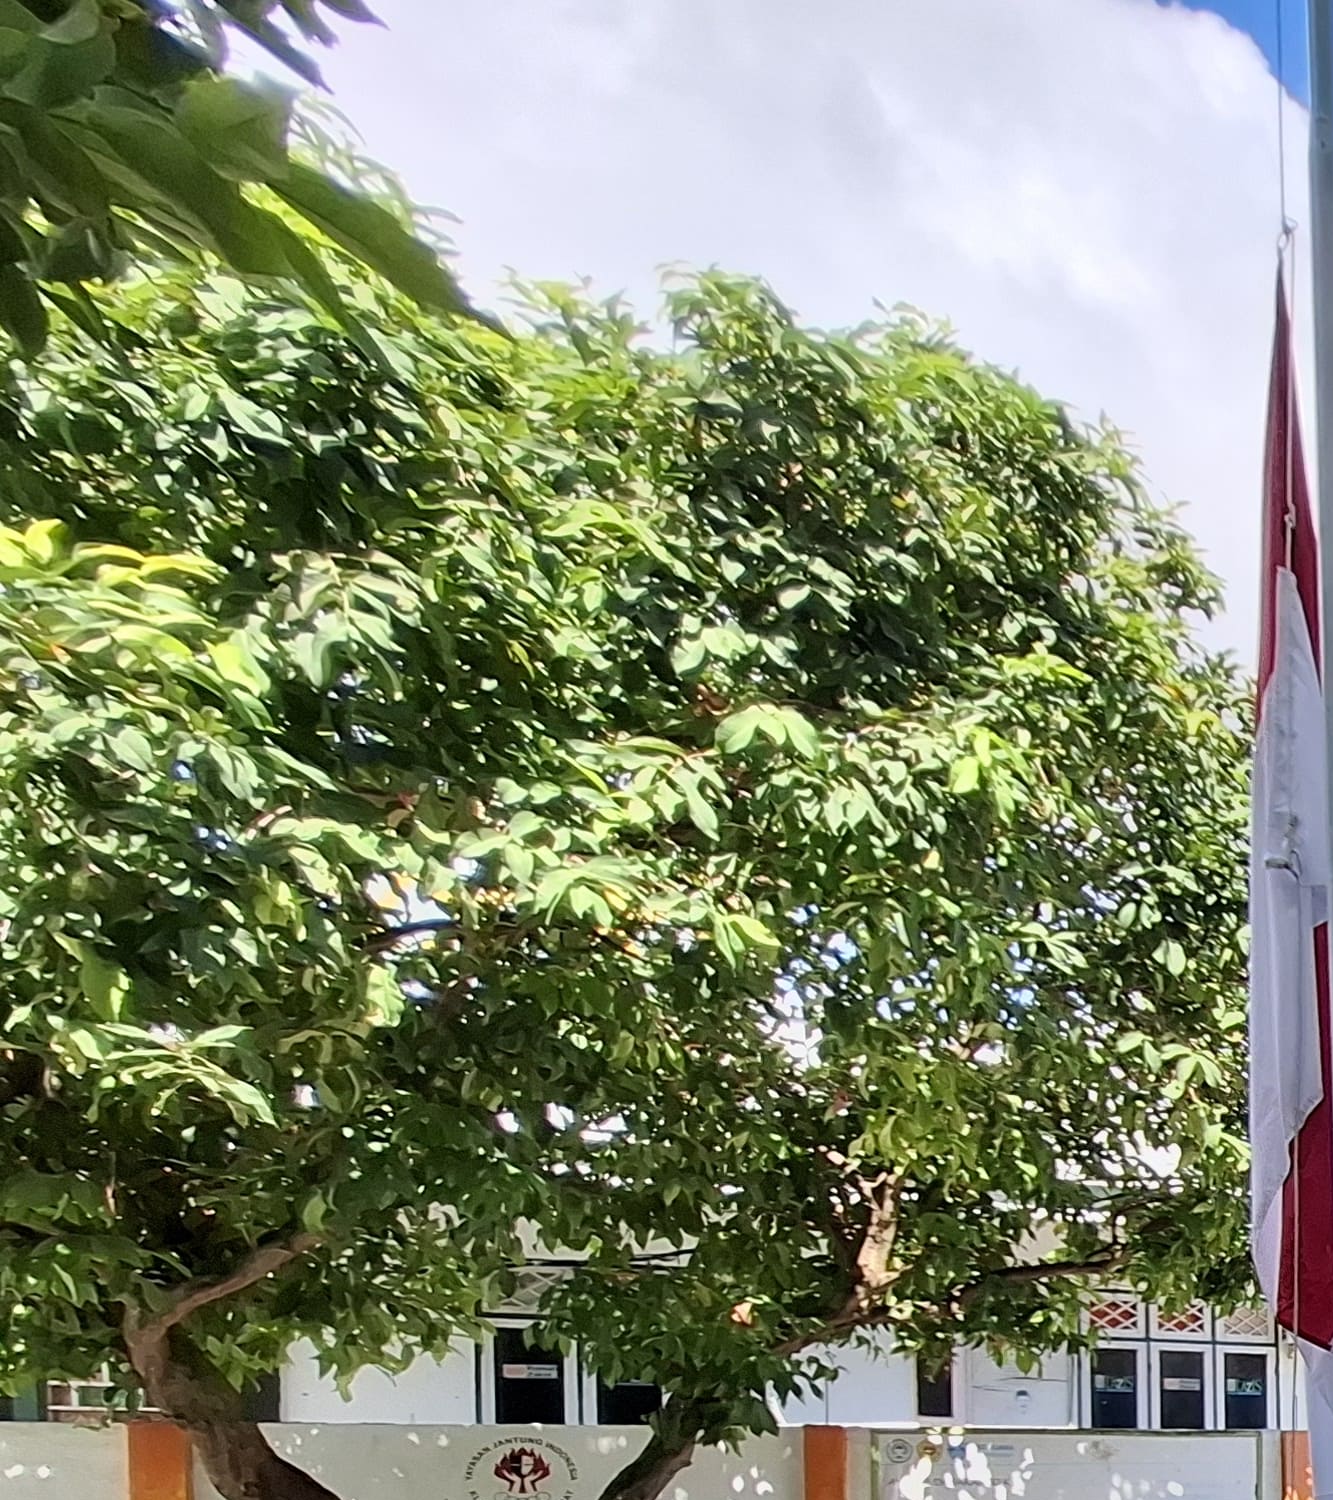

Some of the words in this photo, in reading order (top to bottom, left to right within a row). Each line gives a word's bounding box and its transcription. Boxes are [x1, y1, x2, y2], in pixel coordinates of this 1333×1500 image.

[465, 1446, 491, 1480] YAYASAN
[493, 1437, 543, 1449] JANTUNG
[545, 1441, 578, 1480] INDONESIA
